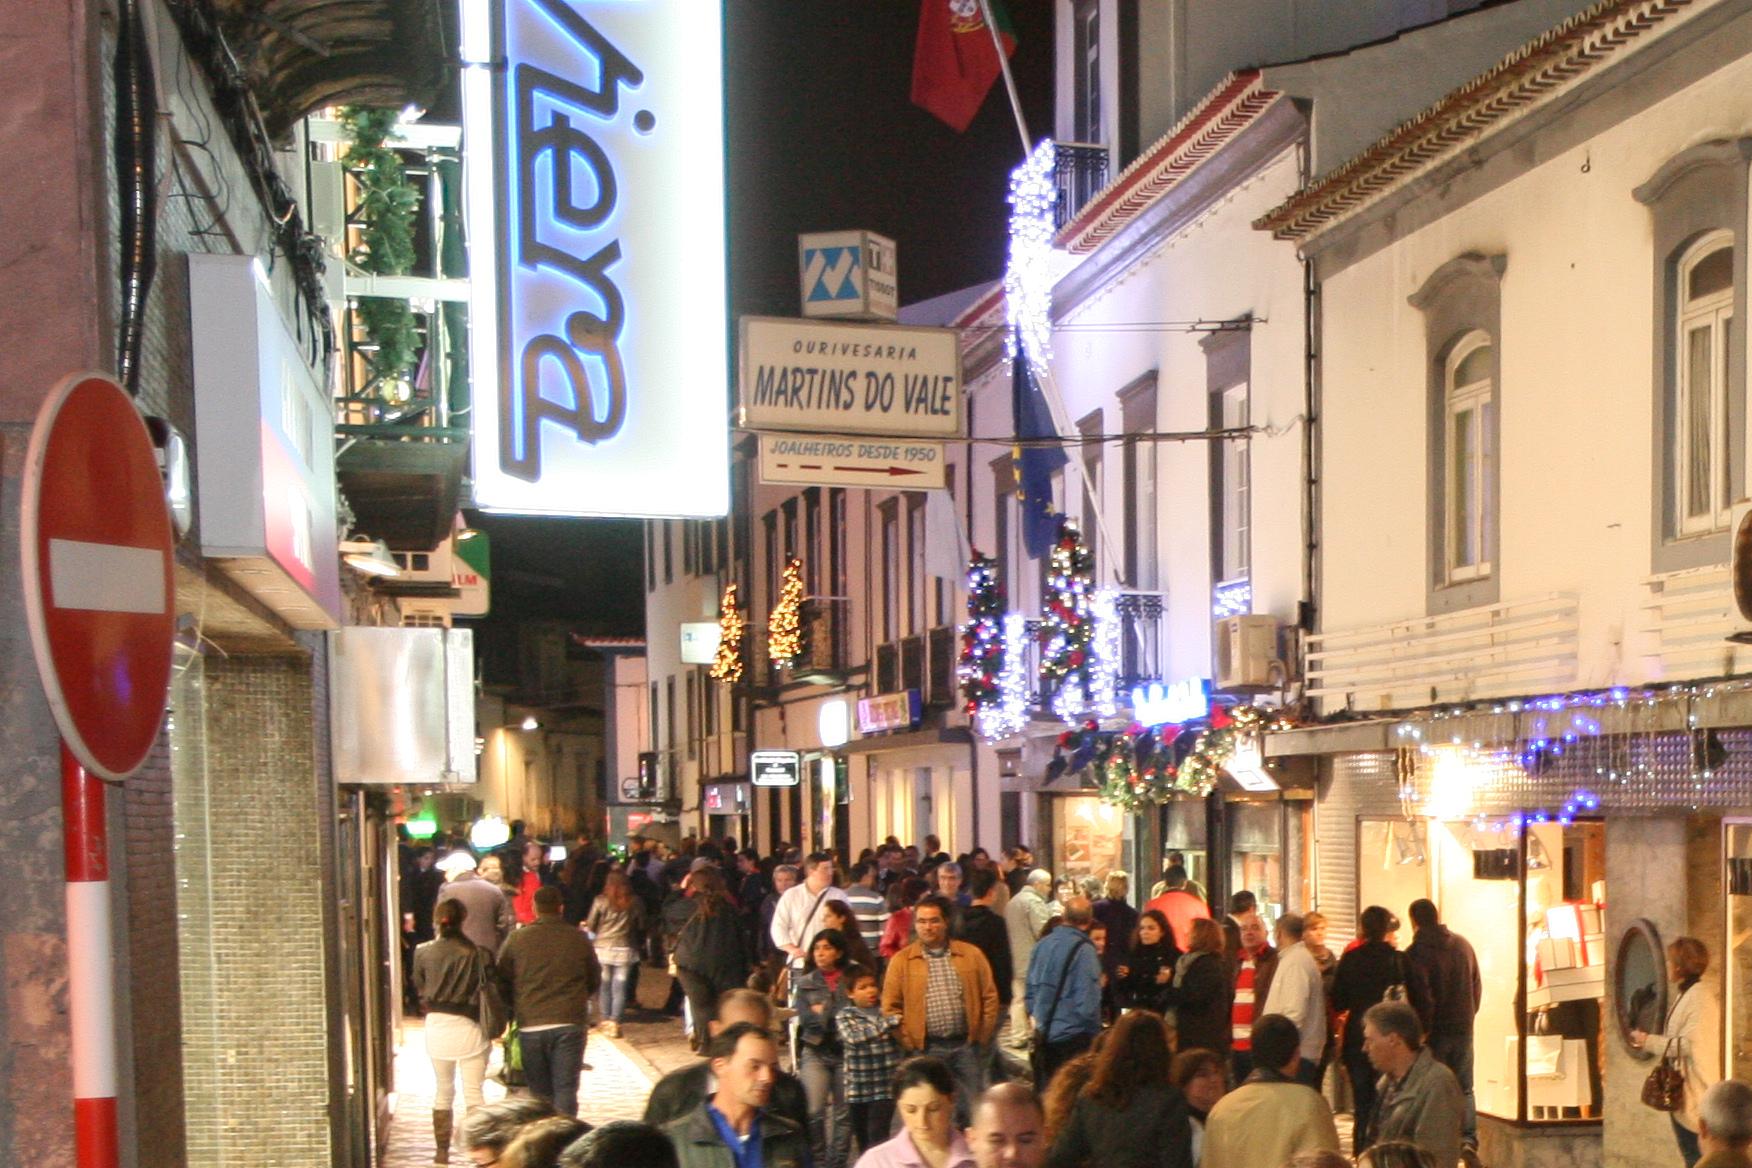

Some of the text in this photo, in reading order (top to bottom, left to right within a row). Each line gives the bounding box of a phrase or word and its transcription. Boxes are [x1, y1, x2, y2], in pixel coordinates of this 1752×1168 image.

[793, 340, 917, 361] OURIVESARIA
[753, 365, 953, 416] MARTINS DO VALE
[770, 440, 937, 462] JOALHEIROS DESDE 1950
